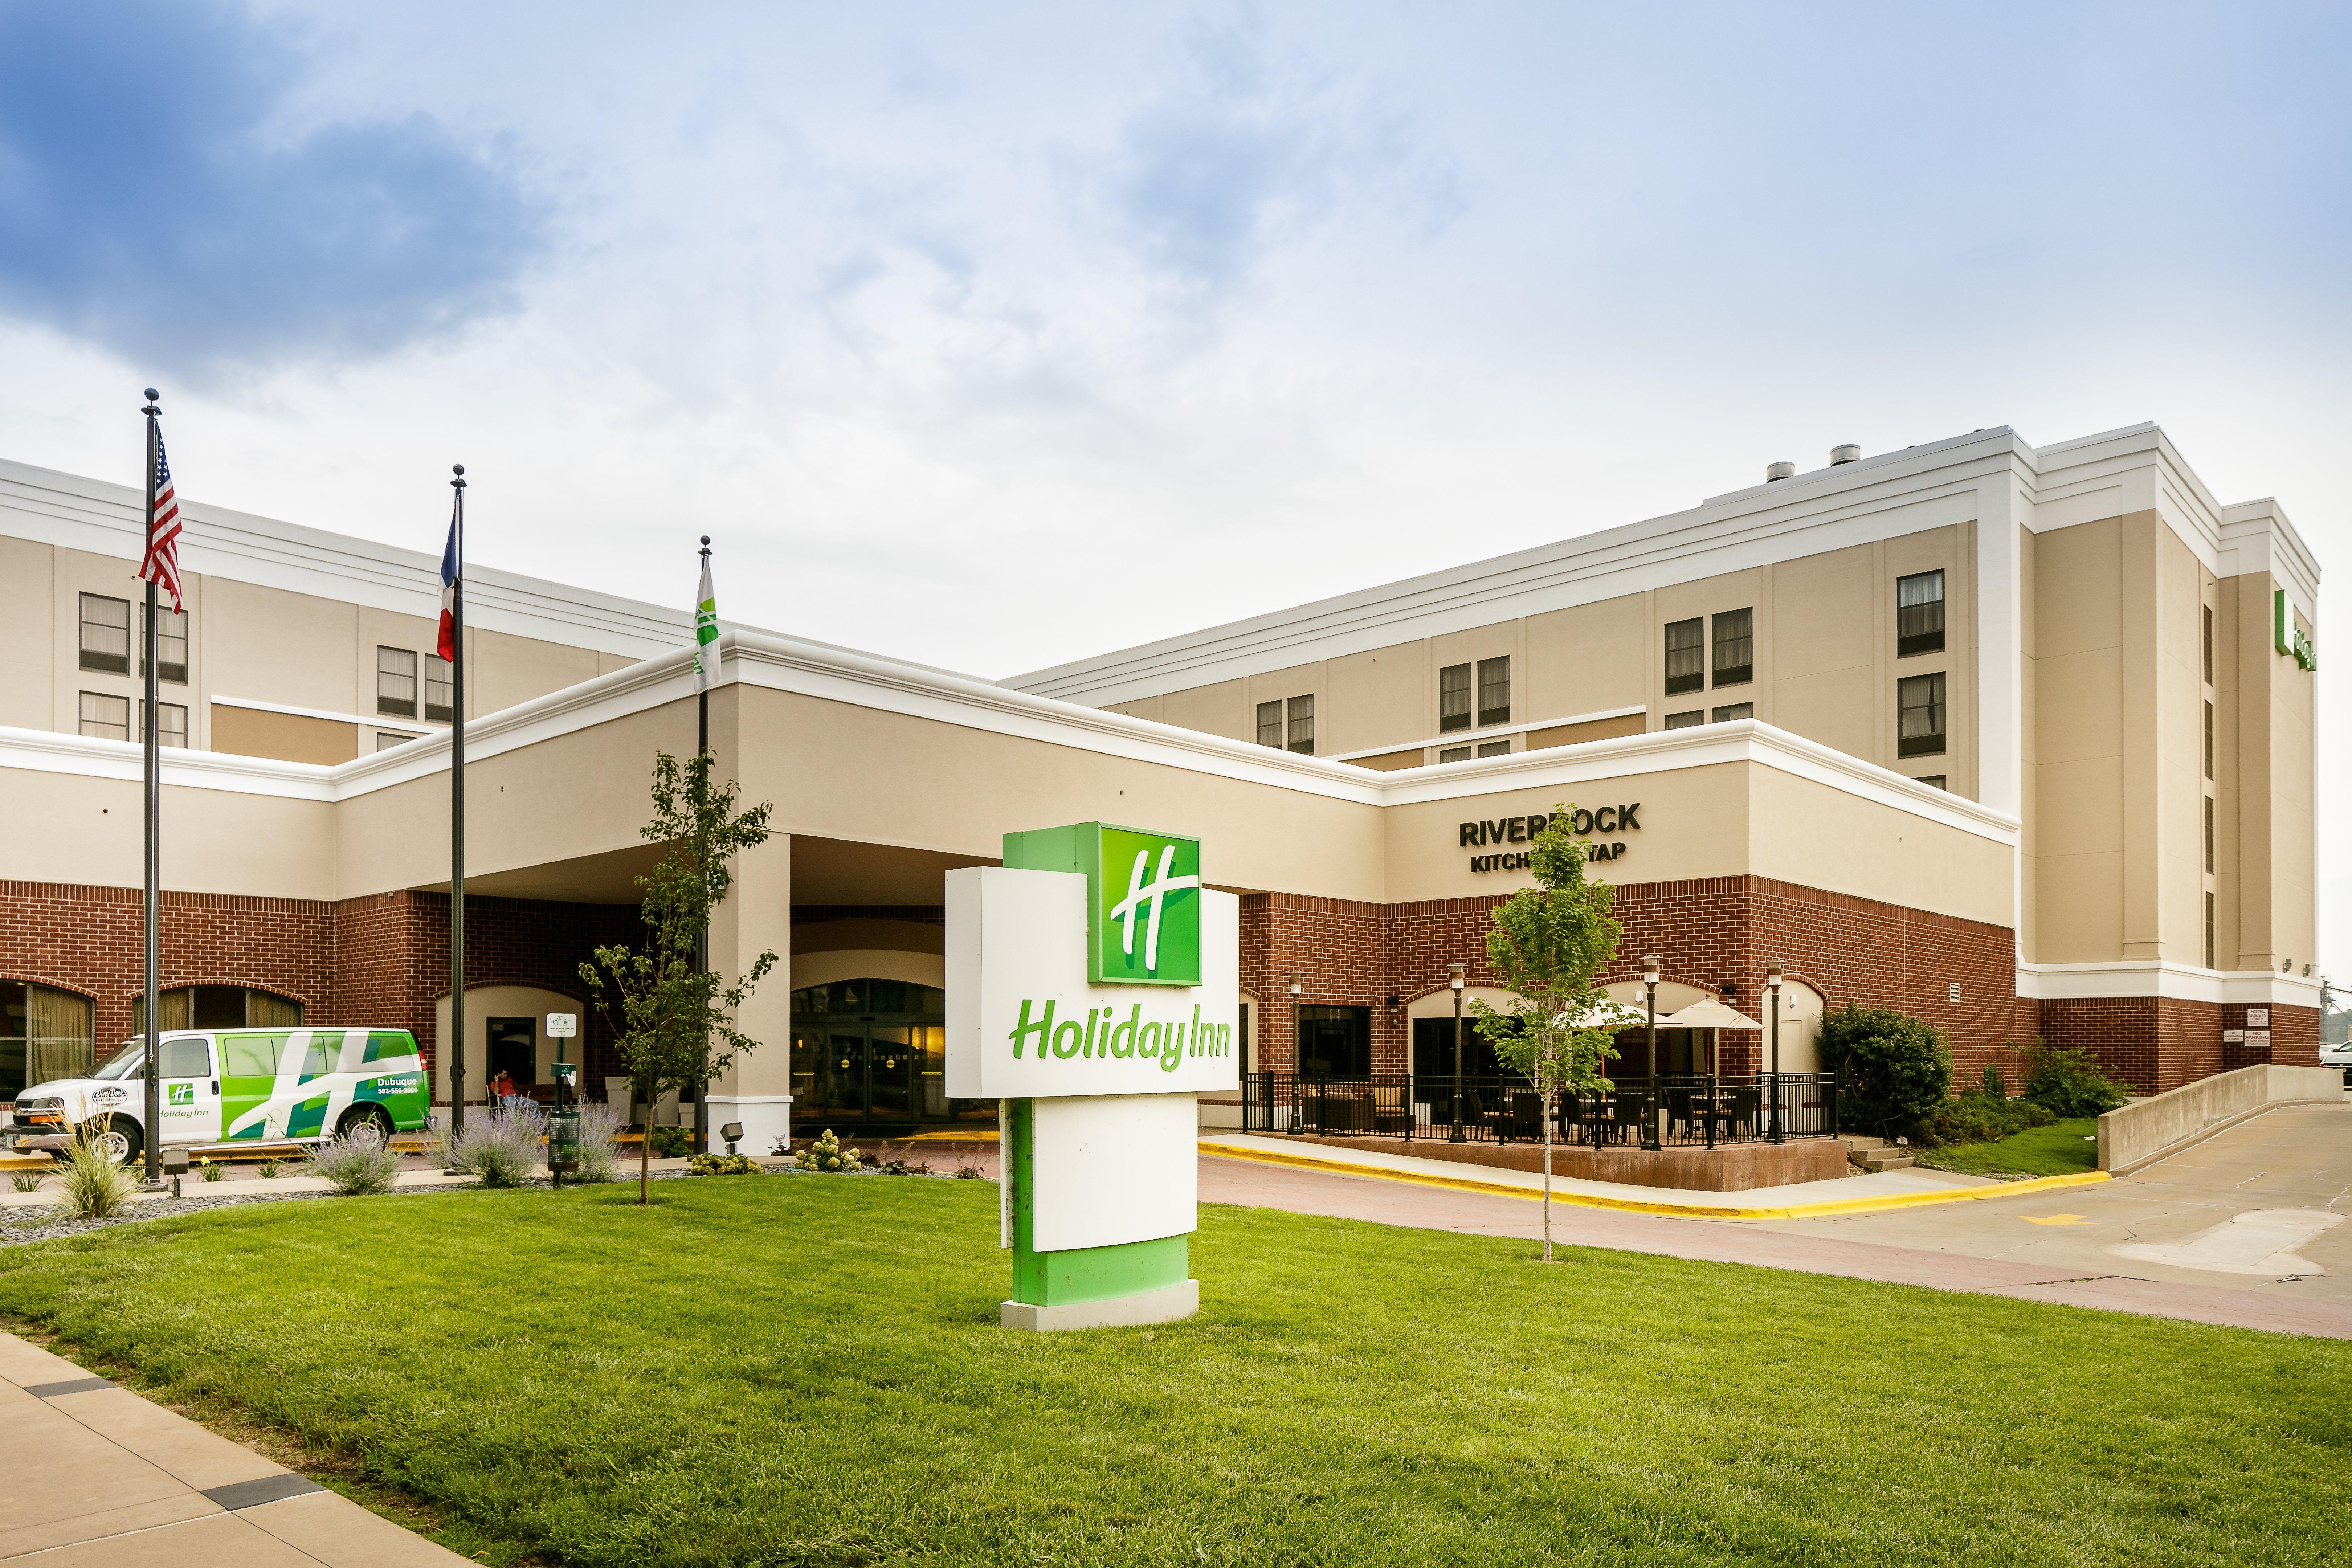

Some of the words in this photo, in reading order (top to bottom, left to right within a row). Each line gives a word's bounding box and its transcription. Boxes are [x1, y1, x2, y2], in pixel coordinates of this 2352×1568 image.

[1009, 999, 1185, 1072] Holiday
[1189, 1004, 1231, 1058] Inn
[377, 1078, 417, 1087] Dubuque
